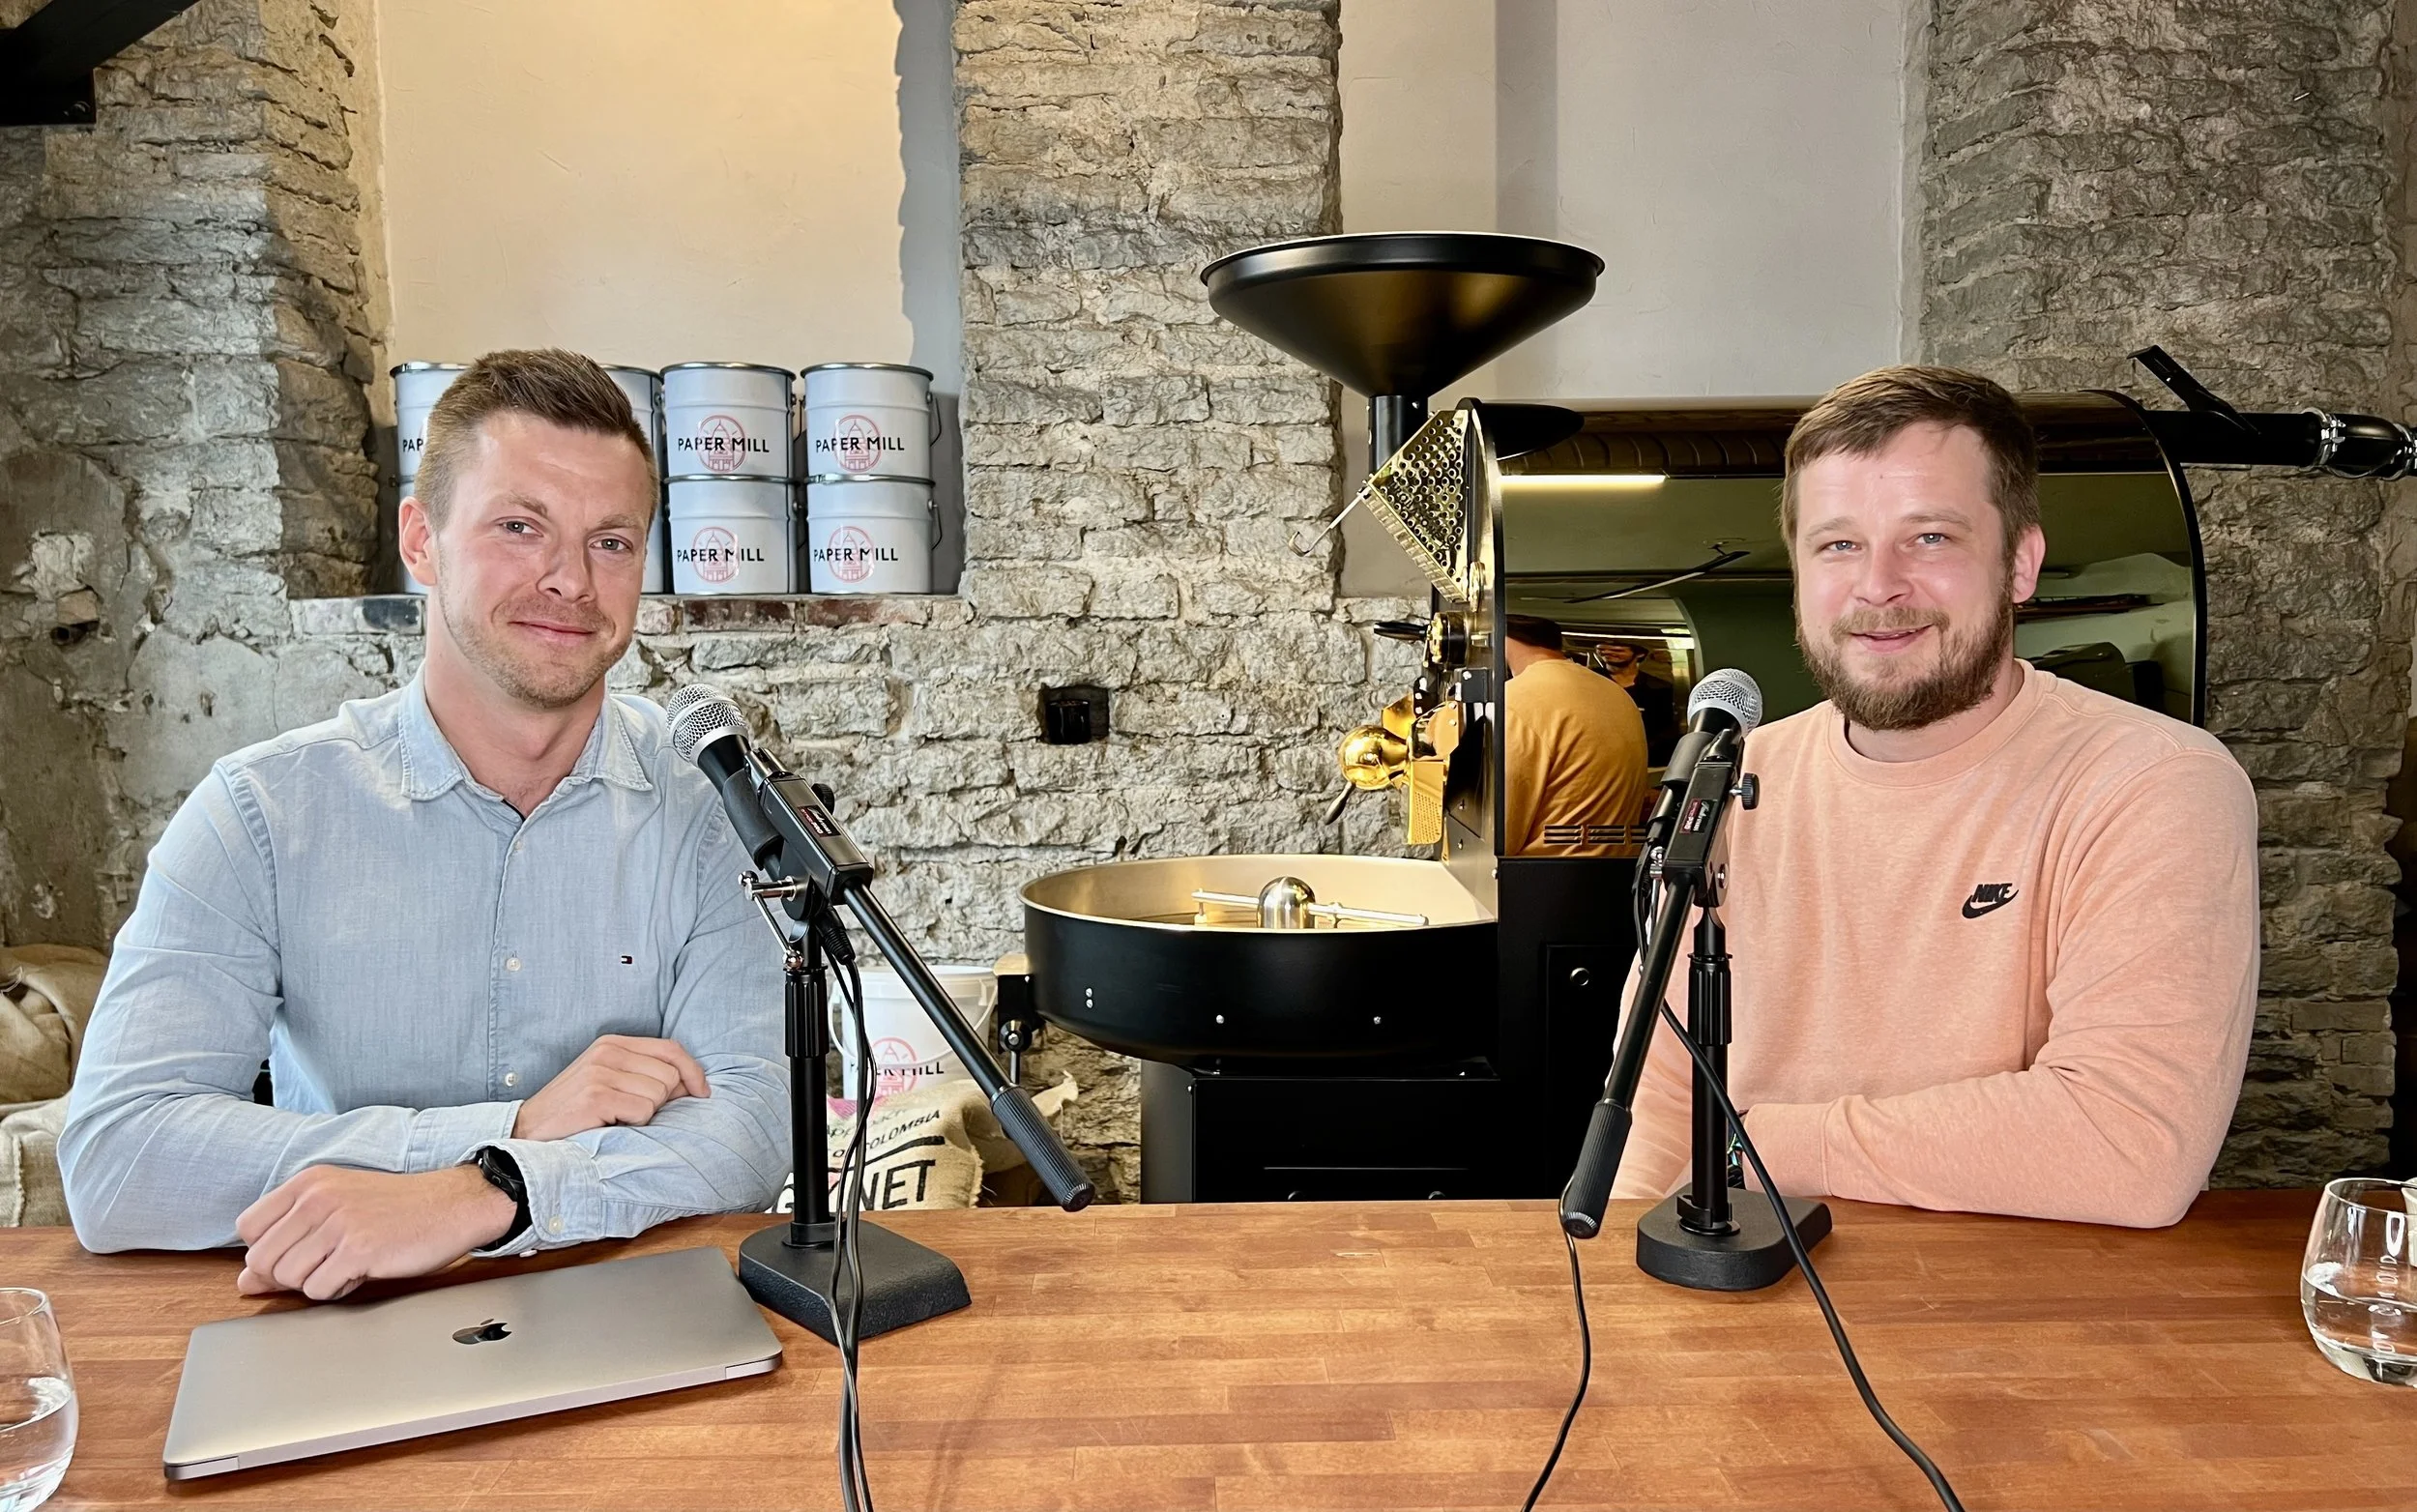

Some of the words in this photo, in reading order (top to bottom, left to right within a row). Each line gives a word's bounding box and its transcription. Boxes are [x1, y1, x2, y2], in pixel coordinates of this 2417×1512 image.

[402, 438, 423, 452] PAP
[678, 437, 725, 451] PAPER
[732, 437, 770, 452] MILL
[815, 437, 860, 452] PAPER
[867, 436, 905, 451] MILL
[677, 548, 718, 563] PAPER
[725, 548, 765, 562] MILL
[813, 548, 854, 562] PAPER
[859, 547, 899, 562] MILL
[1971, 883, 2013, 903] NIKE
[866, 1109, 941, 1149] OLOMBIA
